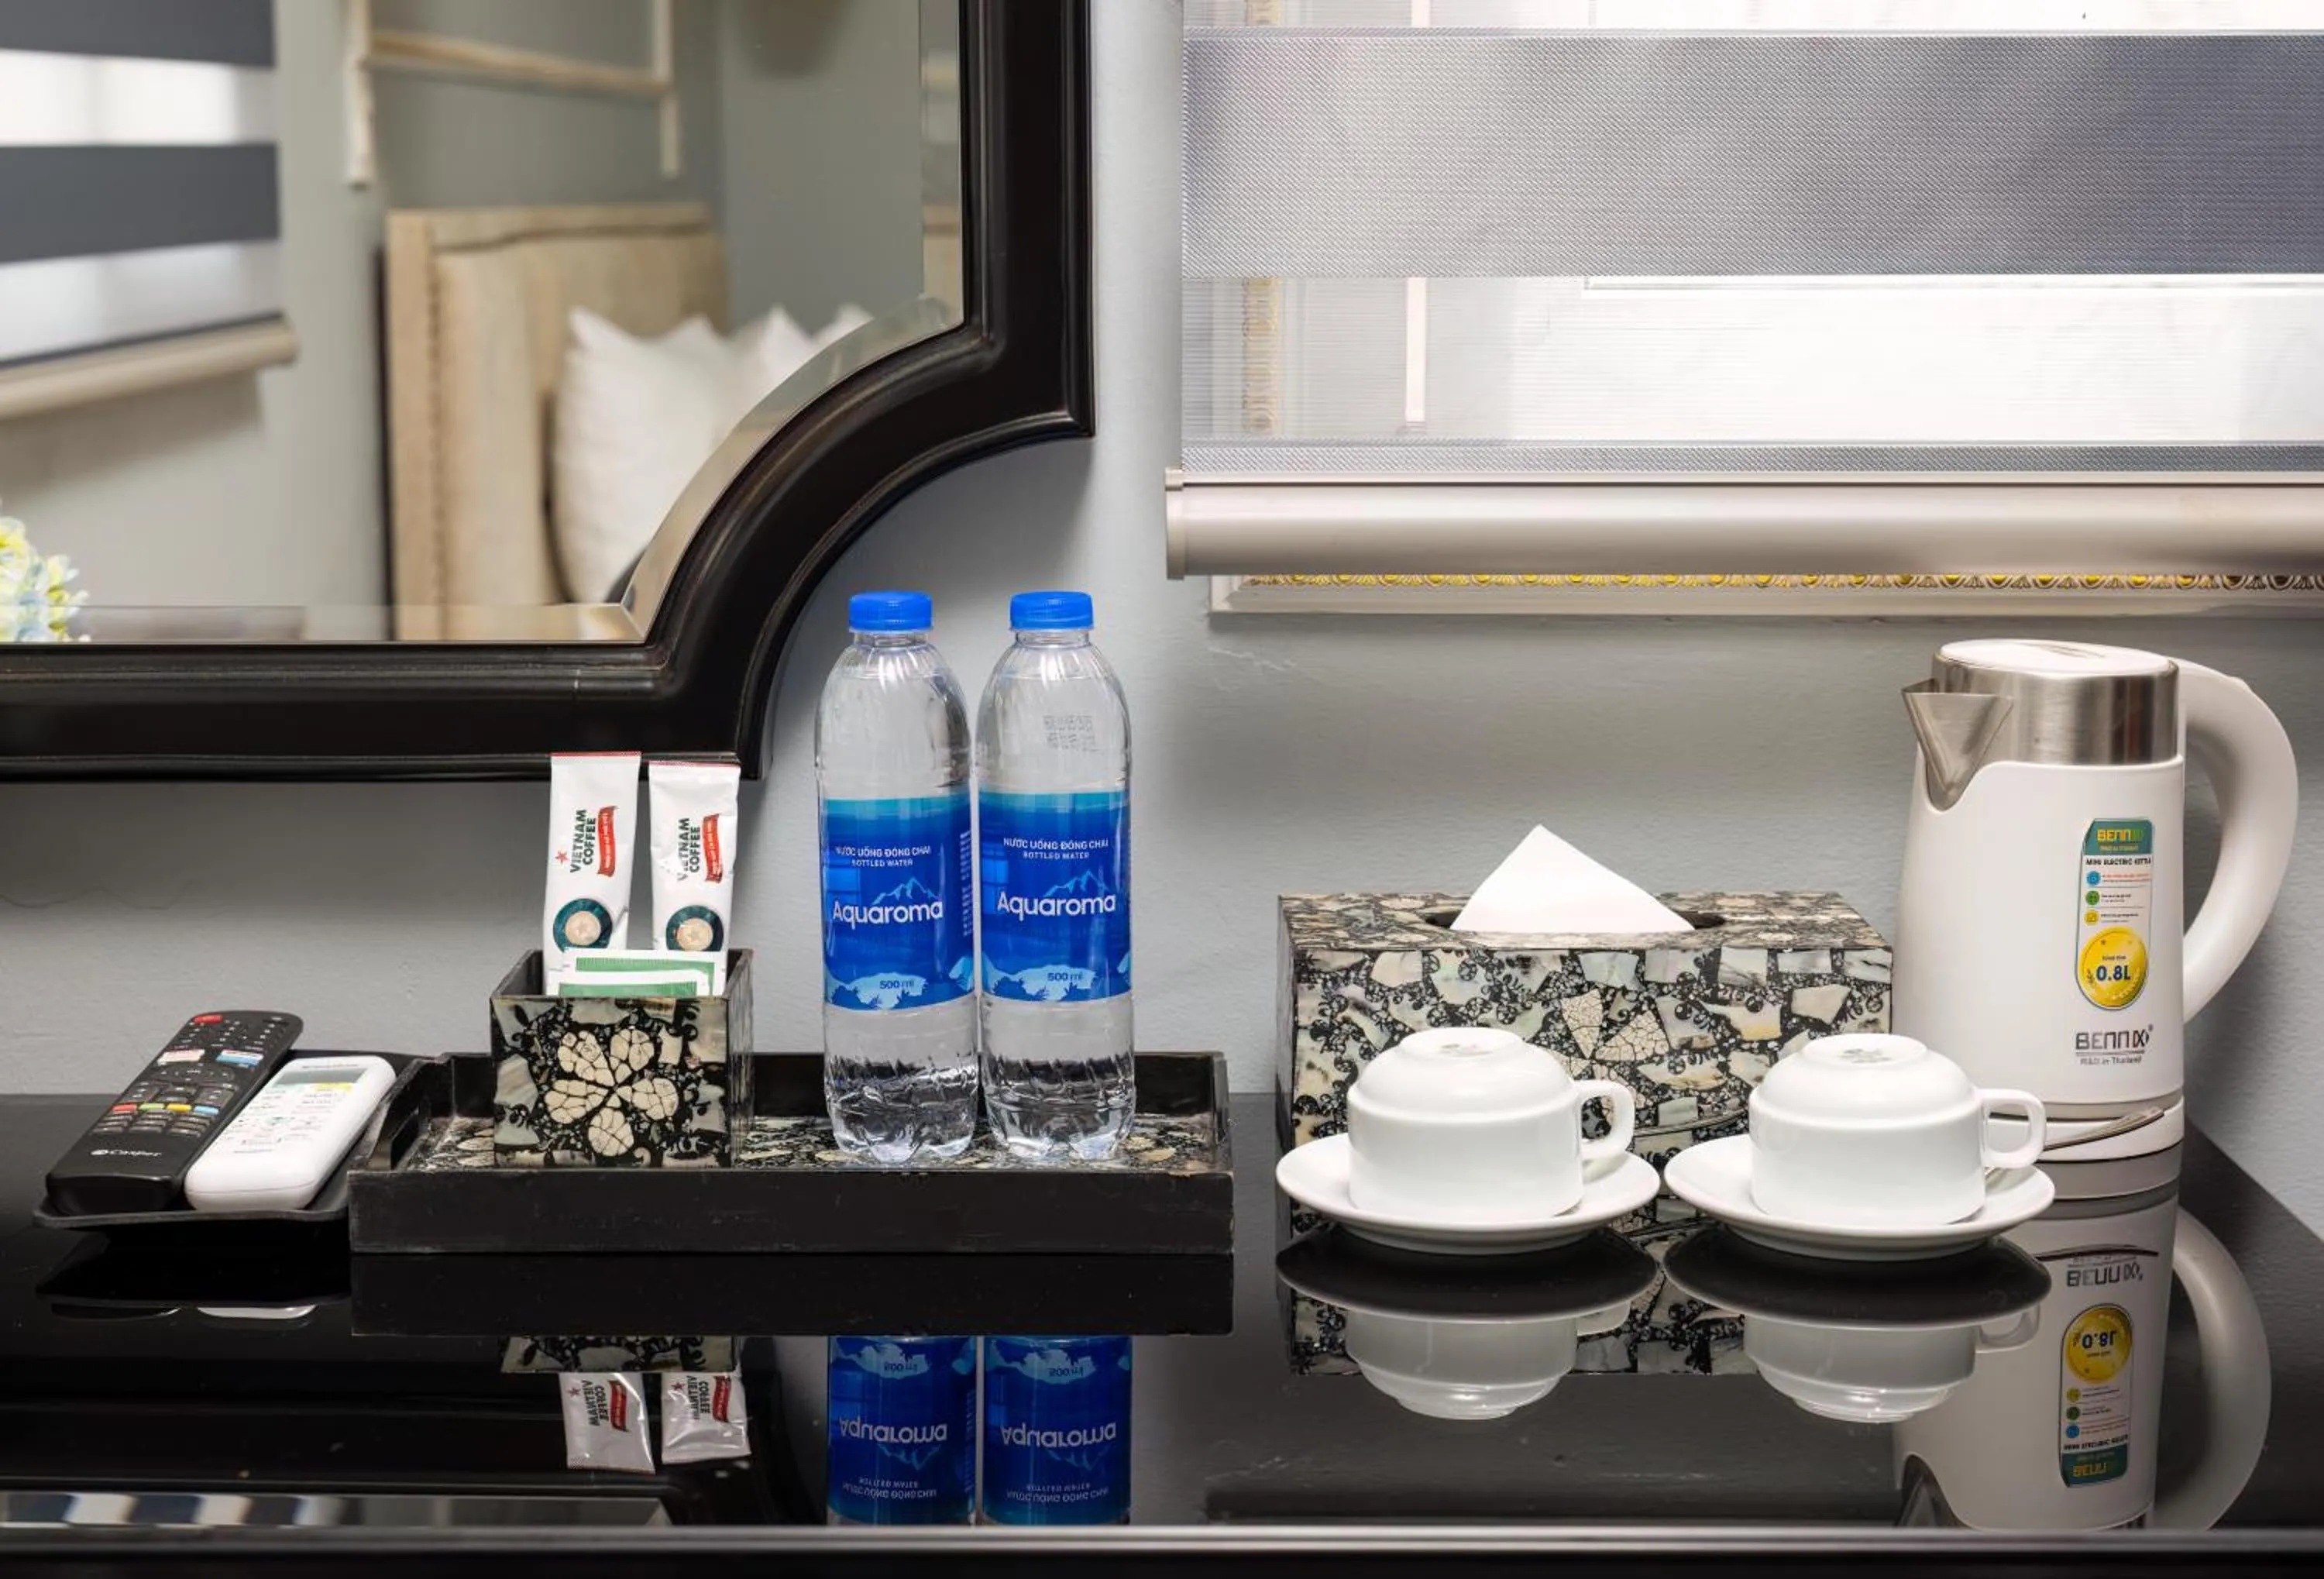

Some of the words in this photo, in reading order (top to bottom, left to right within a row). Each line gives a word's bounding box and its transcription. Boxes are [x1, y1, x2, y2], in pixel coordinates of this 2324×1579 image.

[570, 809, 586, 873] VIETNAM
[583, 817, 597, 865] COFFEE
[689, 825, 701, 873] COFFEE
[886, 858, 913, 867] WATER
[833, 900, 944, 931] Aquaroma
[997, 891, 1116, 921] Aquaroma
[879, 980, 899, 989] 500
[1047, 972, 1068, 981] 500
[2096, 965, 2131, 982] 0.8L
